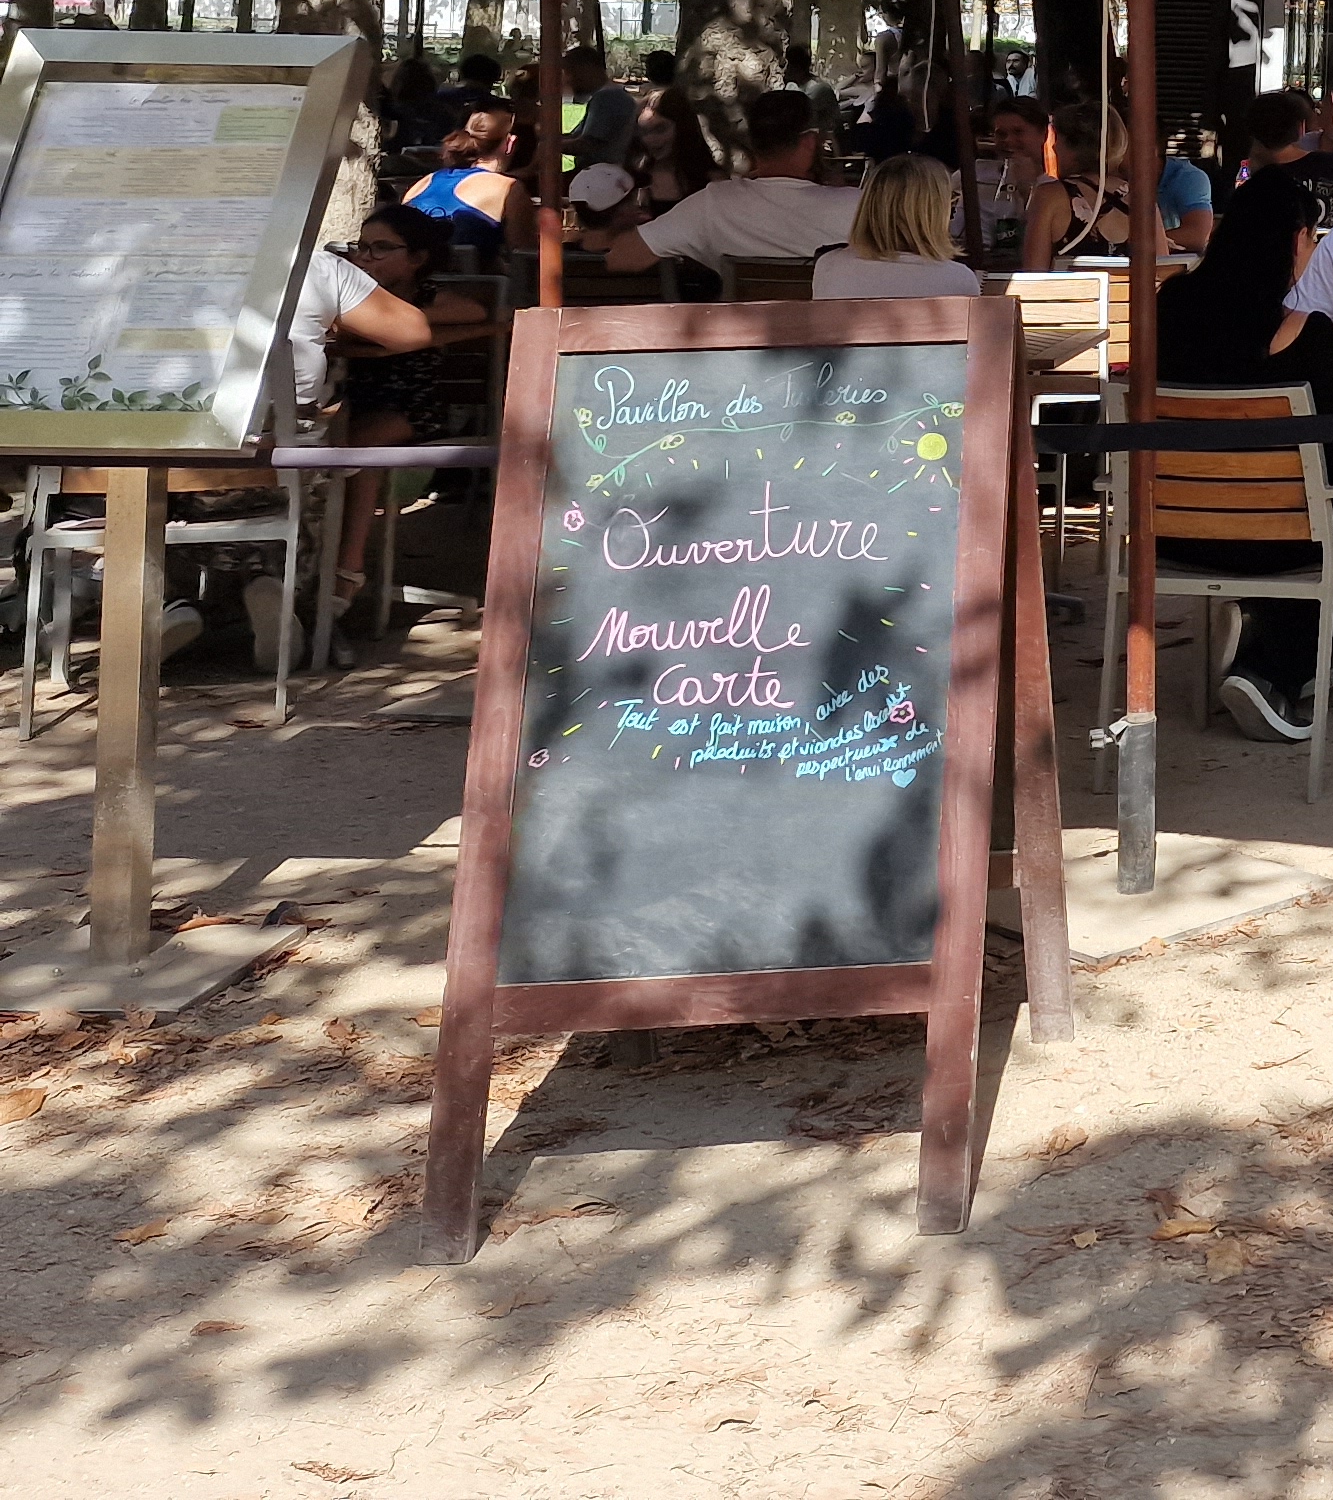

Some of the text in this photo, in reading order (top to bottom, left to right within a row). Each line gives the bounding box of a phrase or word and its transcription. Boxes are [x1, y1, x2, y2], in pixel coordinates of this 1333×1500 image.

[594, 361, 889, 430] Pavillon des Tuleries
[602, 480, 889, 571] Ouverture
[576, 583, 812, 663] Nouvelle
[613, 699, 660, 732] Tout
[667, 713, 701, 736] est
[706, 712, 744, 747] fait
[816, 690, 854, 722] avec
[857, 664, 889, 693] des
[653, 655, 796, 709] Carte
[690, 739, 776, 770] produits
[777, 736, 800, 760] et
[800, 724, 864, 756] viandes
[795, 719, 930, 781] respectueux de
